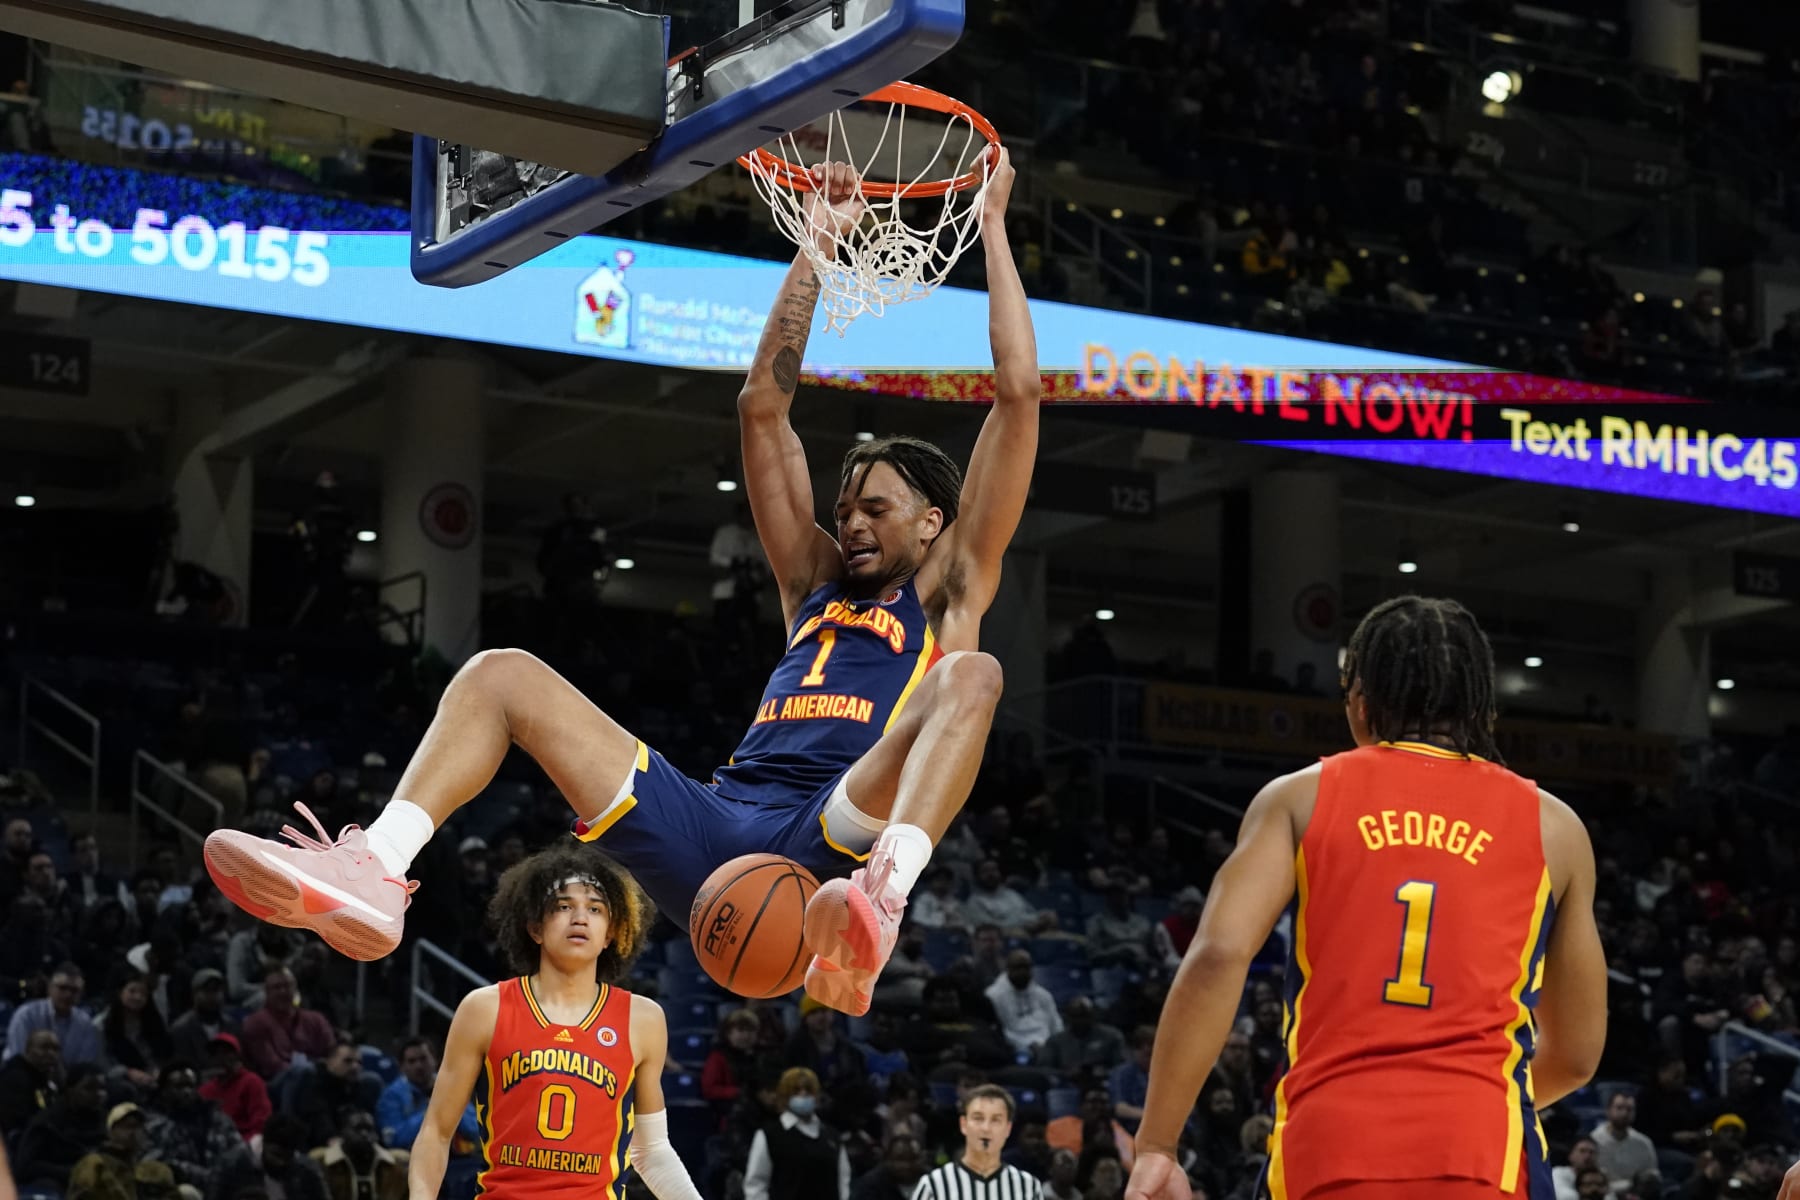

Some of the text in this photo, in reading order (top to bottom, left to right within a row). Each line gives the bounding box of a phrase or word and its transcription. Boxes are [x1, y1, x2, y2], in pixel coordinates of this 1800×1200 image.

[50, 204, 114, 257] to
[130, 207, 330, 287] 50155
[29, 353, 81, 384] 124
[1084, 343, 1473, 443] DONATE NOW!
[1500, 408, 1798, 489] Text RMHC45
[1110, 485, 1151, 514] 125
[801, 627, 836, 687] 1
[753, 694, 875, 727] ALL AMERICAN
[1357, 810, 1493, 865] GEORGE
[704, 901, 736, 957] PRO
[1382, 879, 1437, 1009] 1
[501, 1048, 617, 1099] McDONALD'S
[536, 1083, 577, 1141] 0
[499, 1144, 602, 1175] ALL AMERICAN
